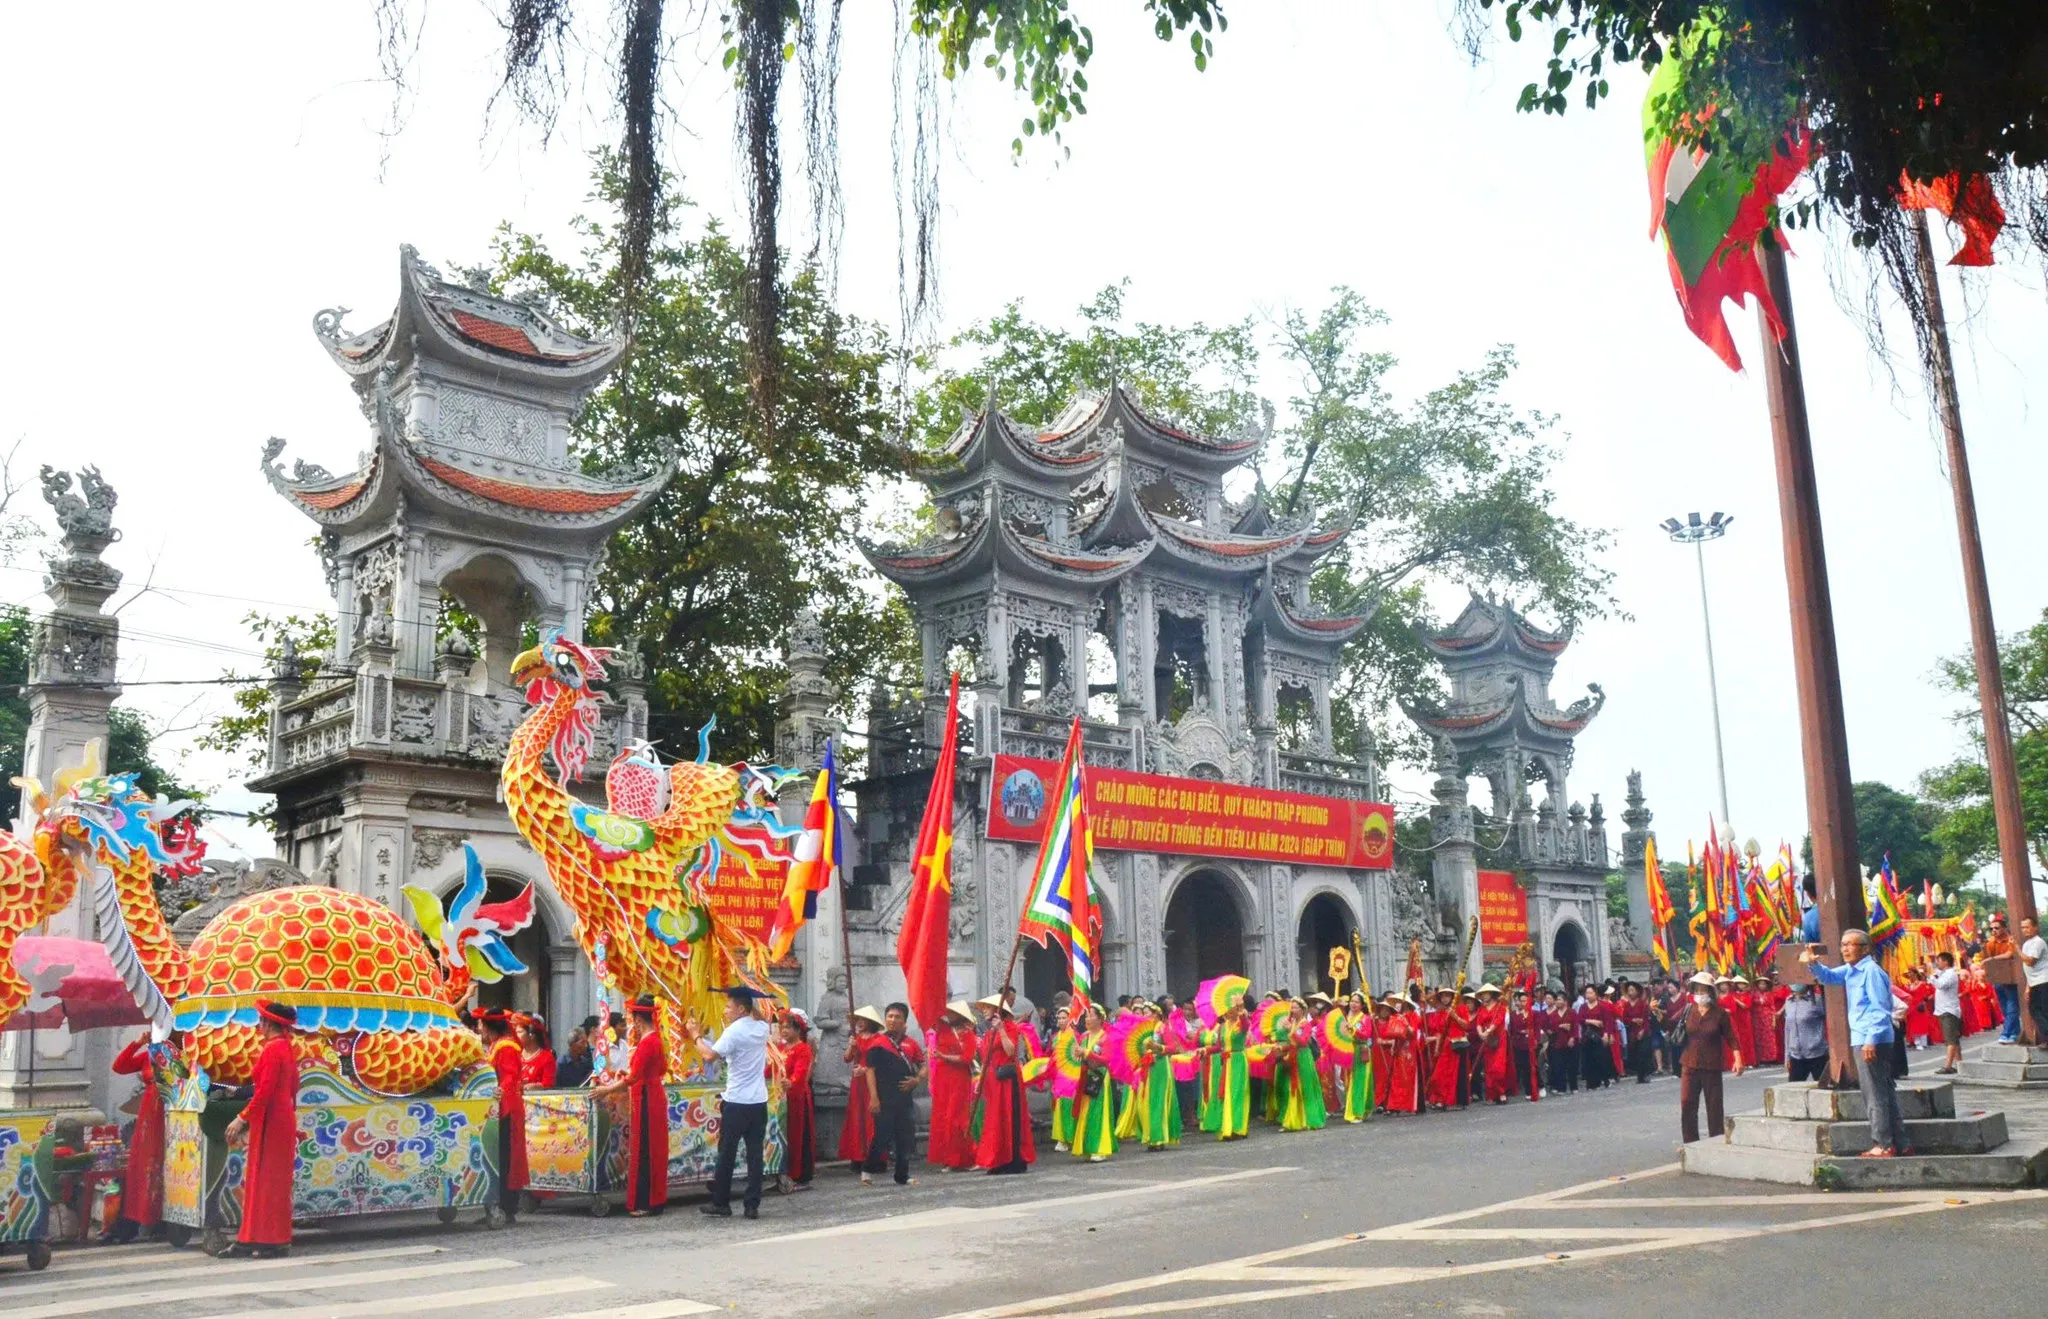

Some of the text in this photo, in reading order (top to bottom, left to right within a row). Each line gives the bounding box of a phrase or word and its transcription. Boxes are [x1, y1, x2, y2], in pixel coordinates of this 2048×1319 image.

[1095, 778, 1125, 803] CHÀO
[1126, 781, 1157, 807] MỪNG
[1158, 785, 1178, 809] CÁC
[1179, 790, 1196, 815] ĐẠI
[1223, 793, 1242, 817] QUÝ
[1243, 795, 1272, 819] KHÁCH
[1273, 799, 1295, 826] THẬP
[1295, 804, 1329, 826] PHƯƠNG
[1096, 809, 1110, 838] LỄ
[1110, 815, 1129, 843] HỘI
[1131, 815, 1170, 843] TRUYỀN
[1171, 818, 1202, 845] THỐNG
[1203, 821, 1222, 847] ĐỀN
[1224, 825, 1245, 849] TIÊN
[1246, 831, 1257, 850] LA
[1257, 829, 1278, 852] NĂM
[1279, 834, 1300, 854] 2024
